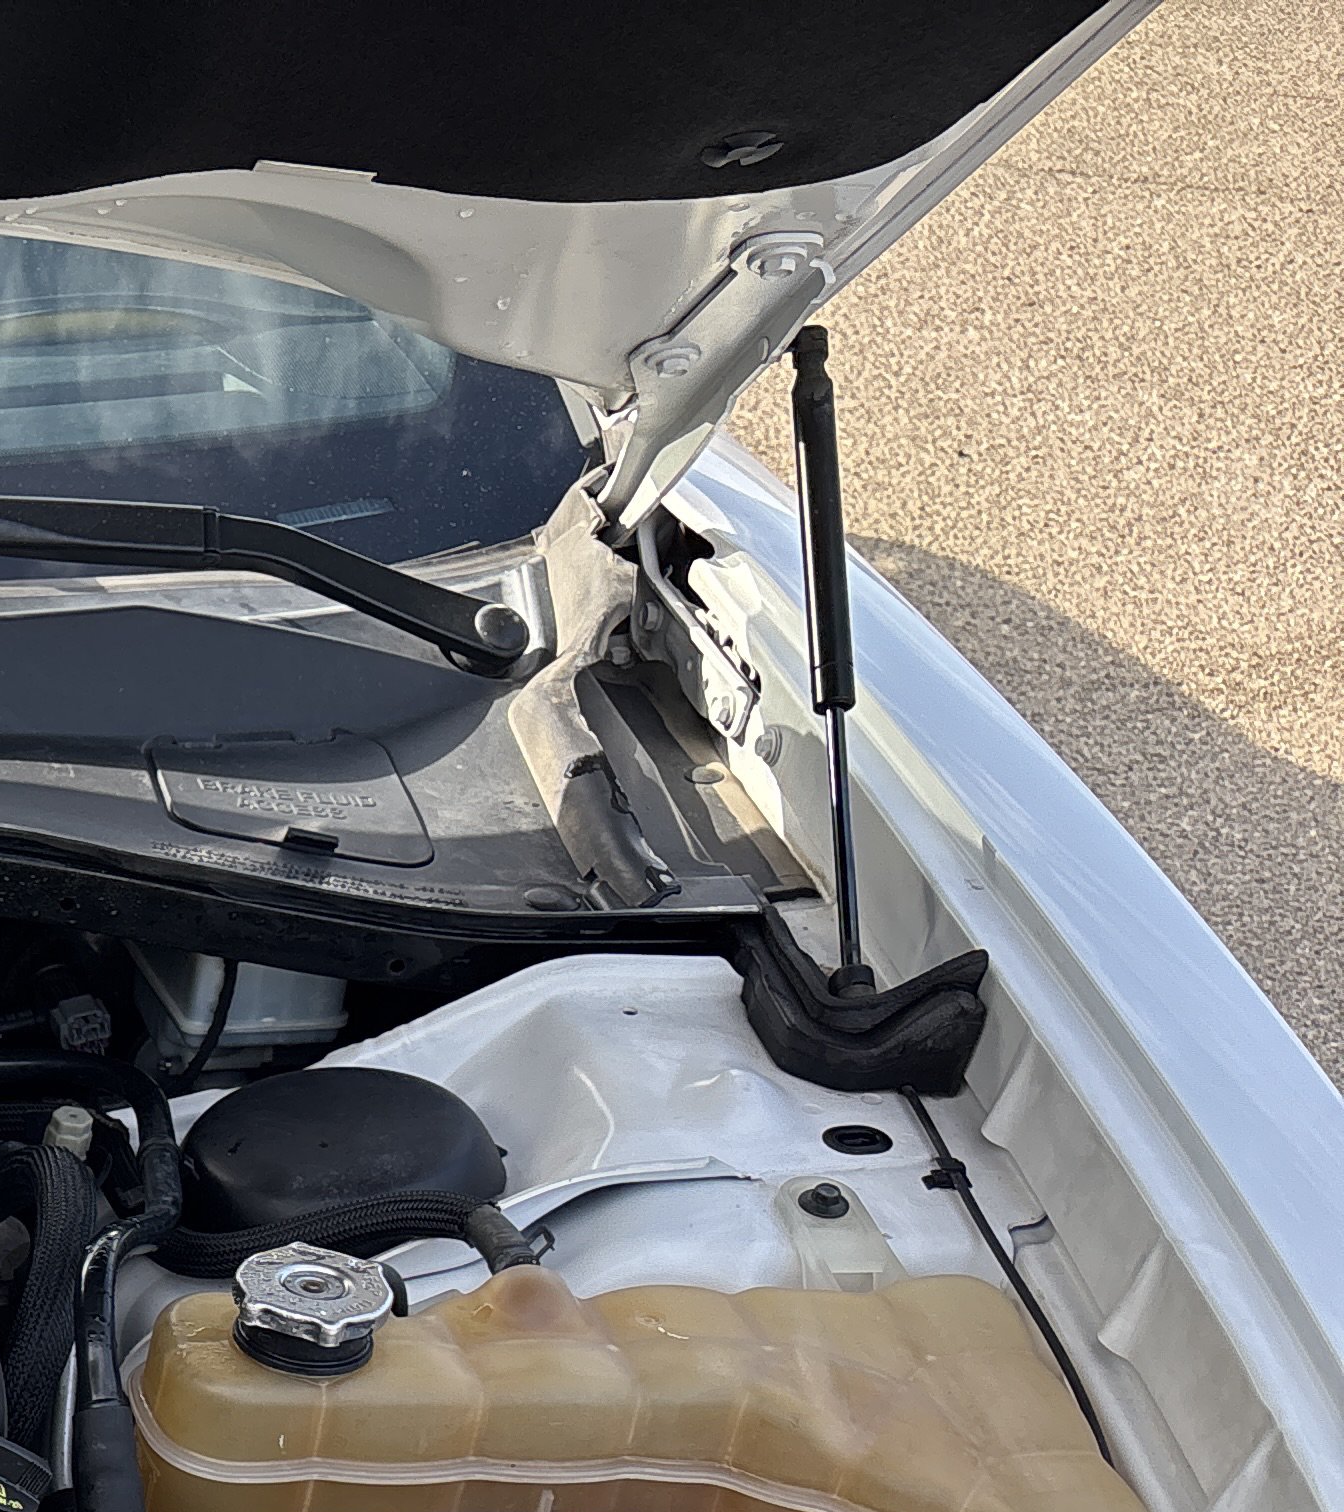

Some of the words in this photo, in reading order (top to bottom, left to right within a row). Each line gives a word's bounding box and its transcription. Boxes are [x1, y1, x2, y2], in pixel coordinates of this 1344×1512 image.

[196, 777, 293, 801] BRAKE
[295, 789, 377, 808] FLUID
[237, 796, 347, 820] ACCESS
